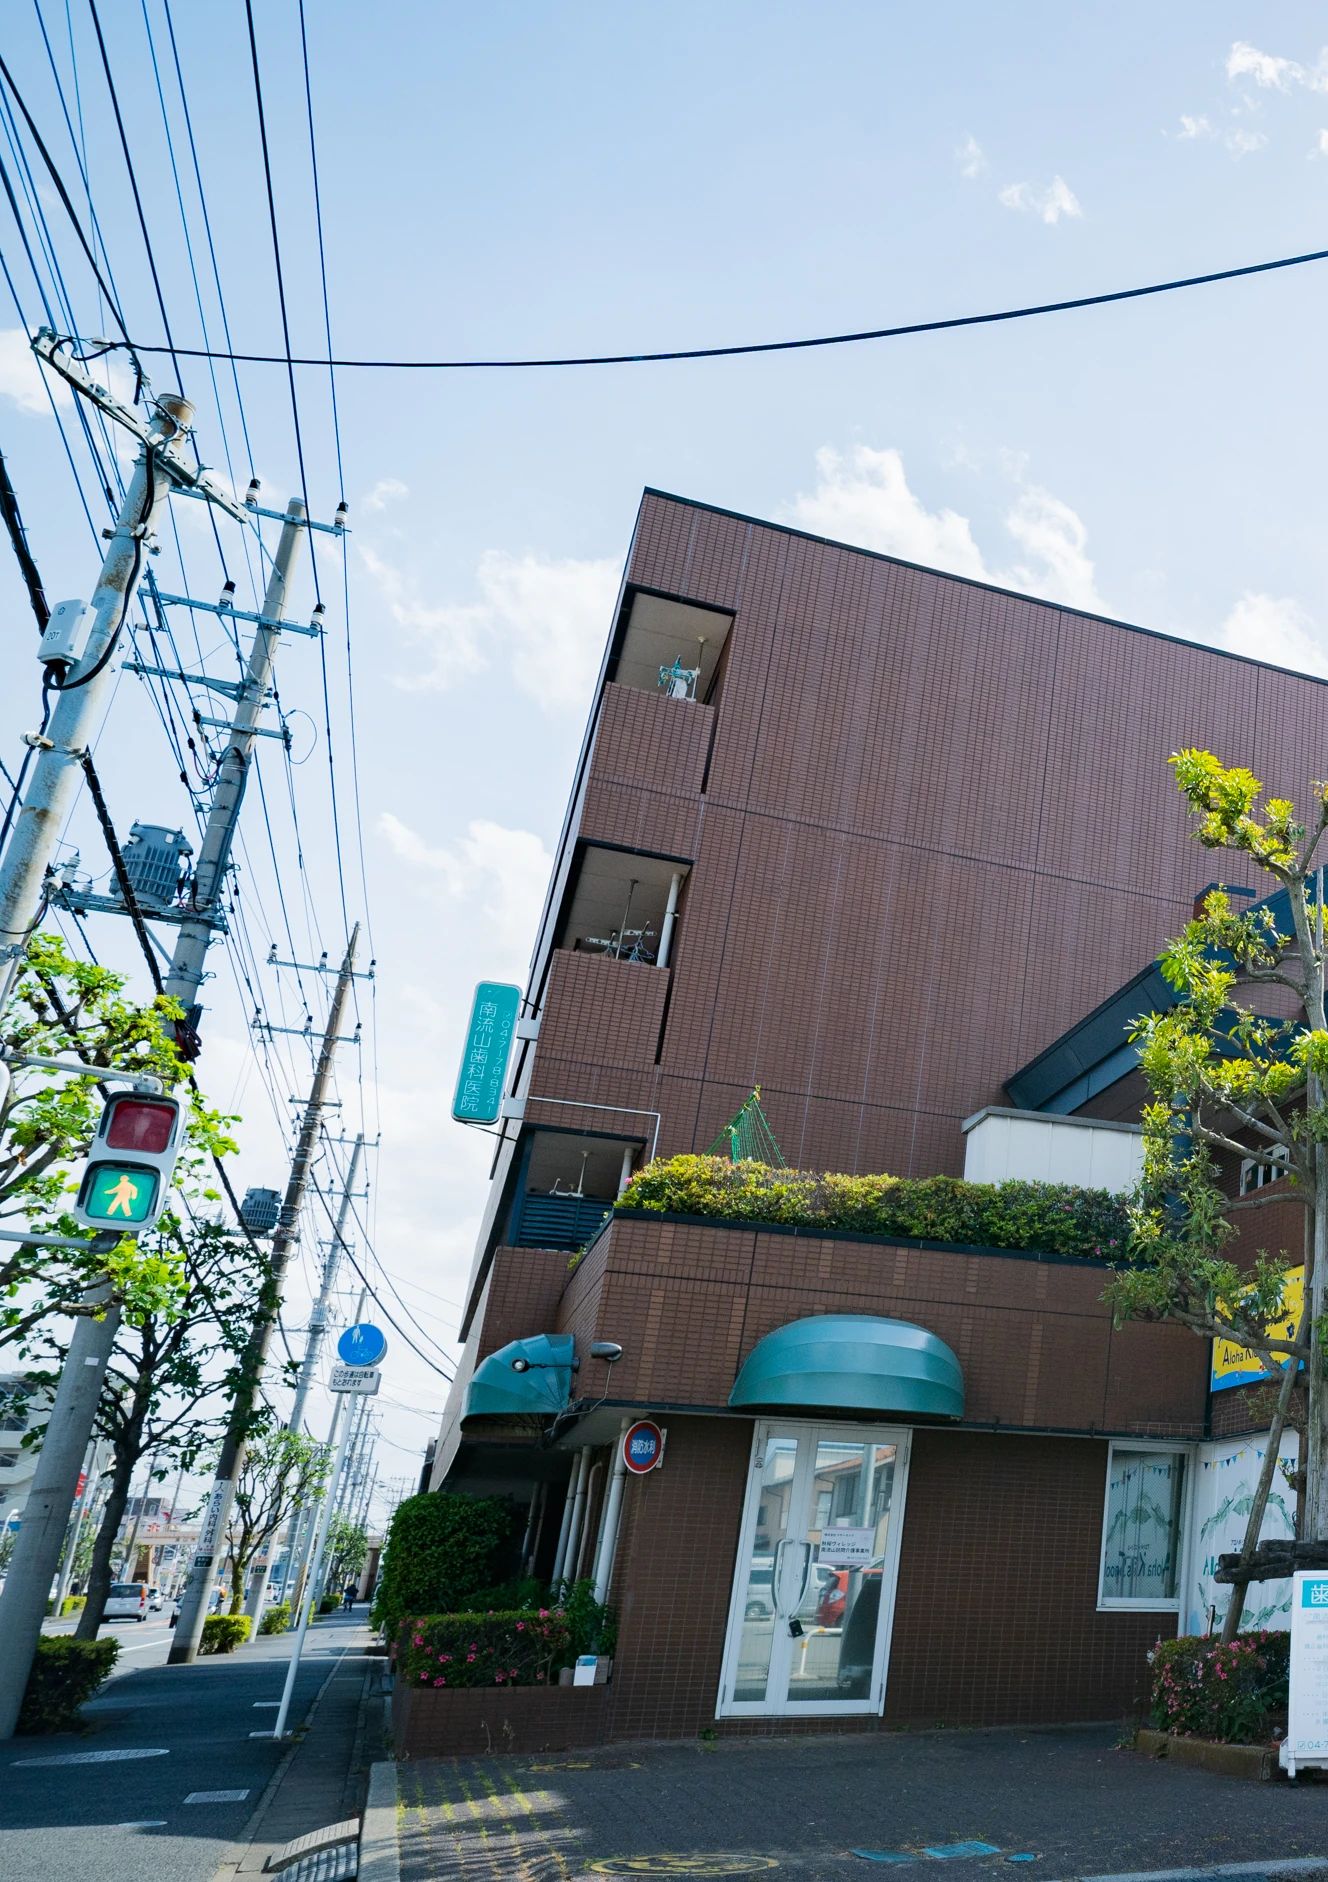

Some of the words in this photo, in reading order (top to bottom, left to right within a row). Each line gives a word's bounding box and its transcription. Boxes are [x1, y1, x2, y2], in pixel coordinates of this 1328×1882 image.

[460, 1001, 498, 1112] 南流山歯科医院
